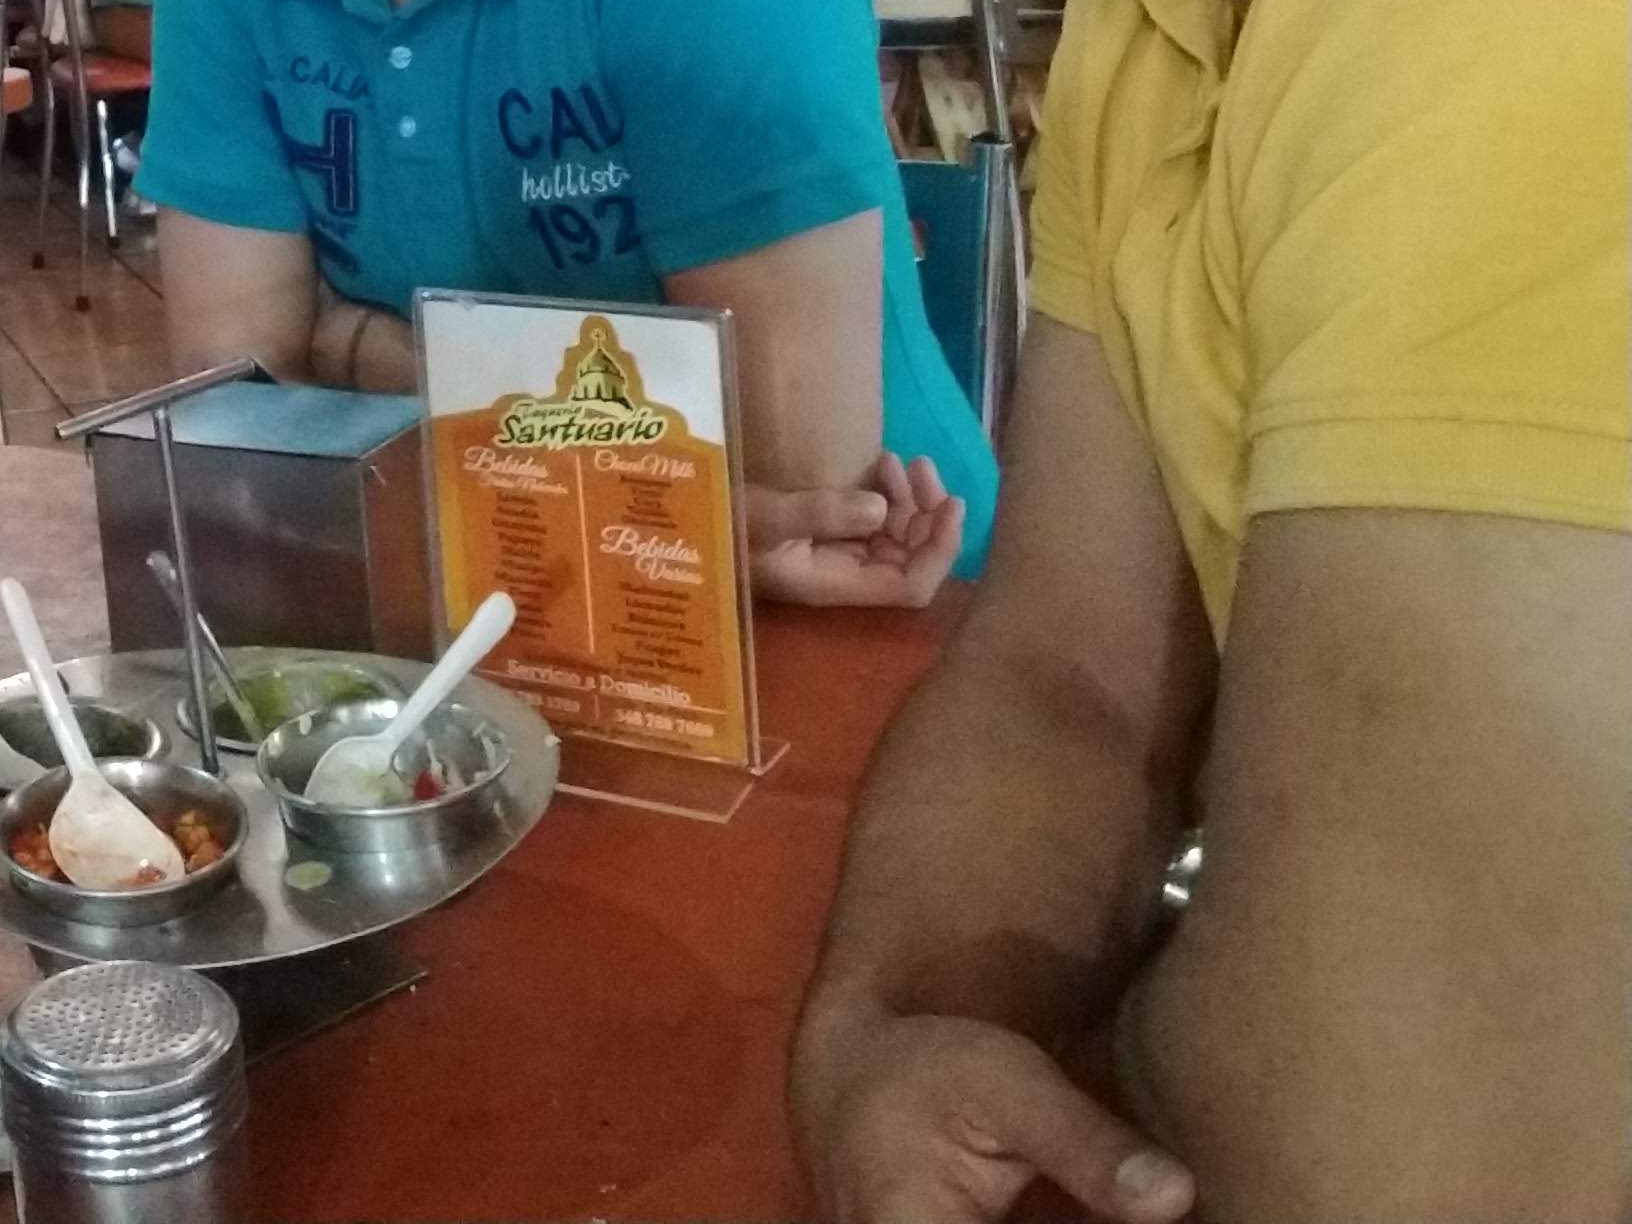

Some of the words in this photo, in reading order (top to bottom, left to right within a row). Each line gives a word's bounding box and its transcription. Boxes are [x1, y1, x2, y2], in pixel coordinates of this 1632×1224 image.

[498, 411, 664, 444] Santuario
[599, 524, 700, 563] Bebidas
[507, 659, 581, 686] Servicio
[599, 674, 691, 705] Domicilio
